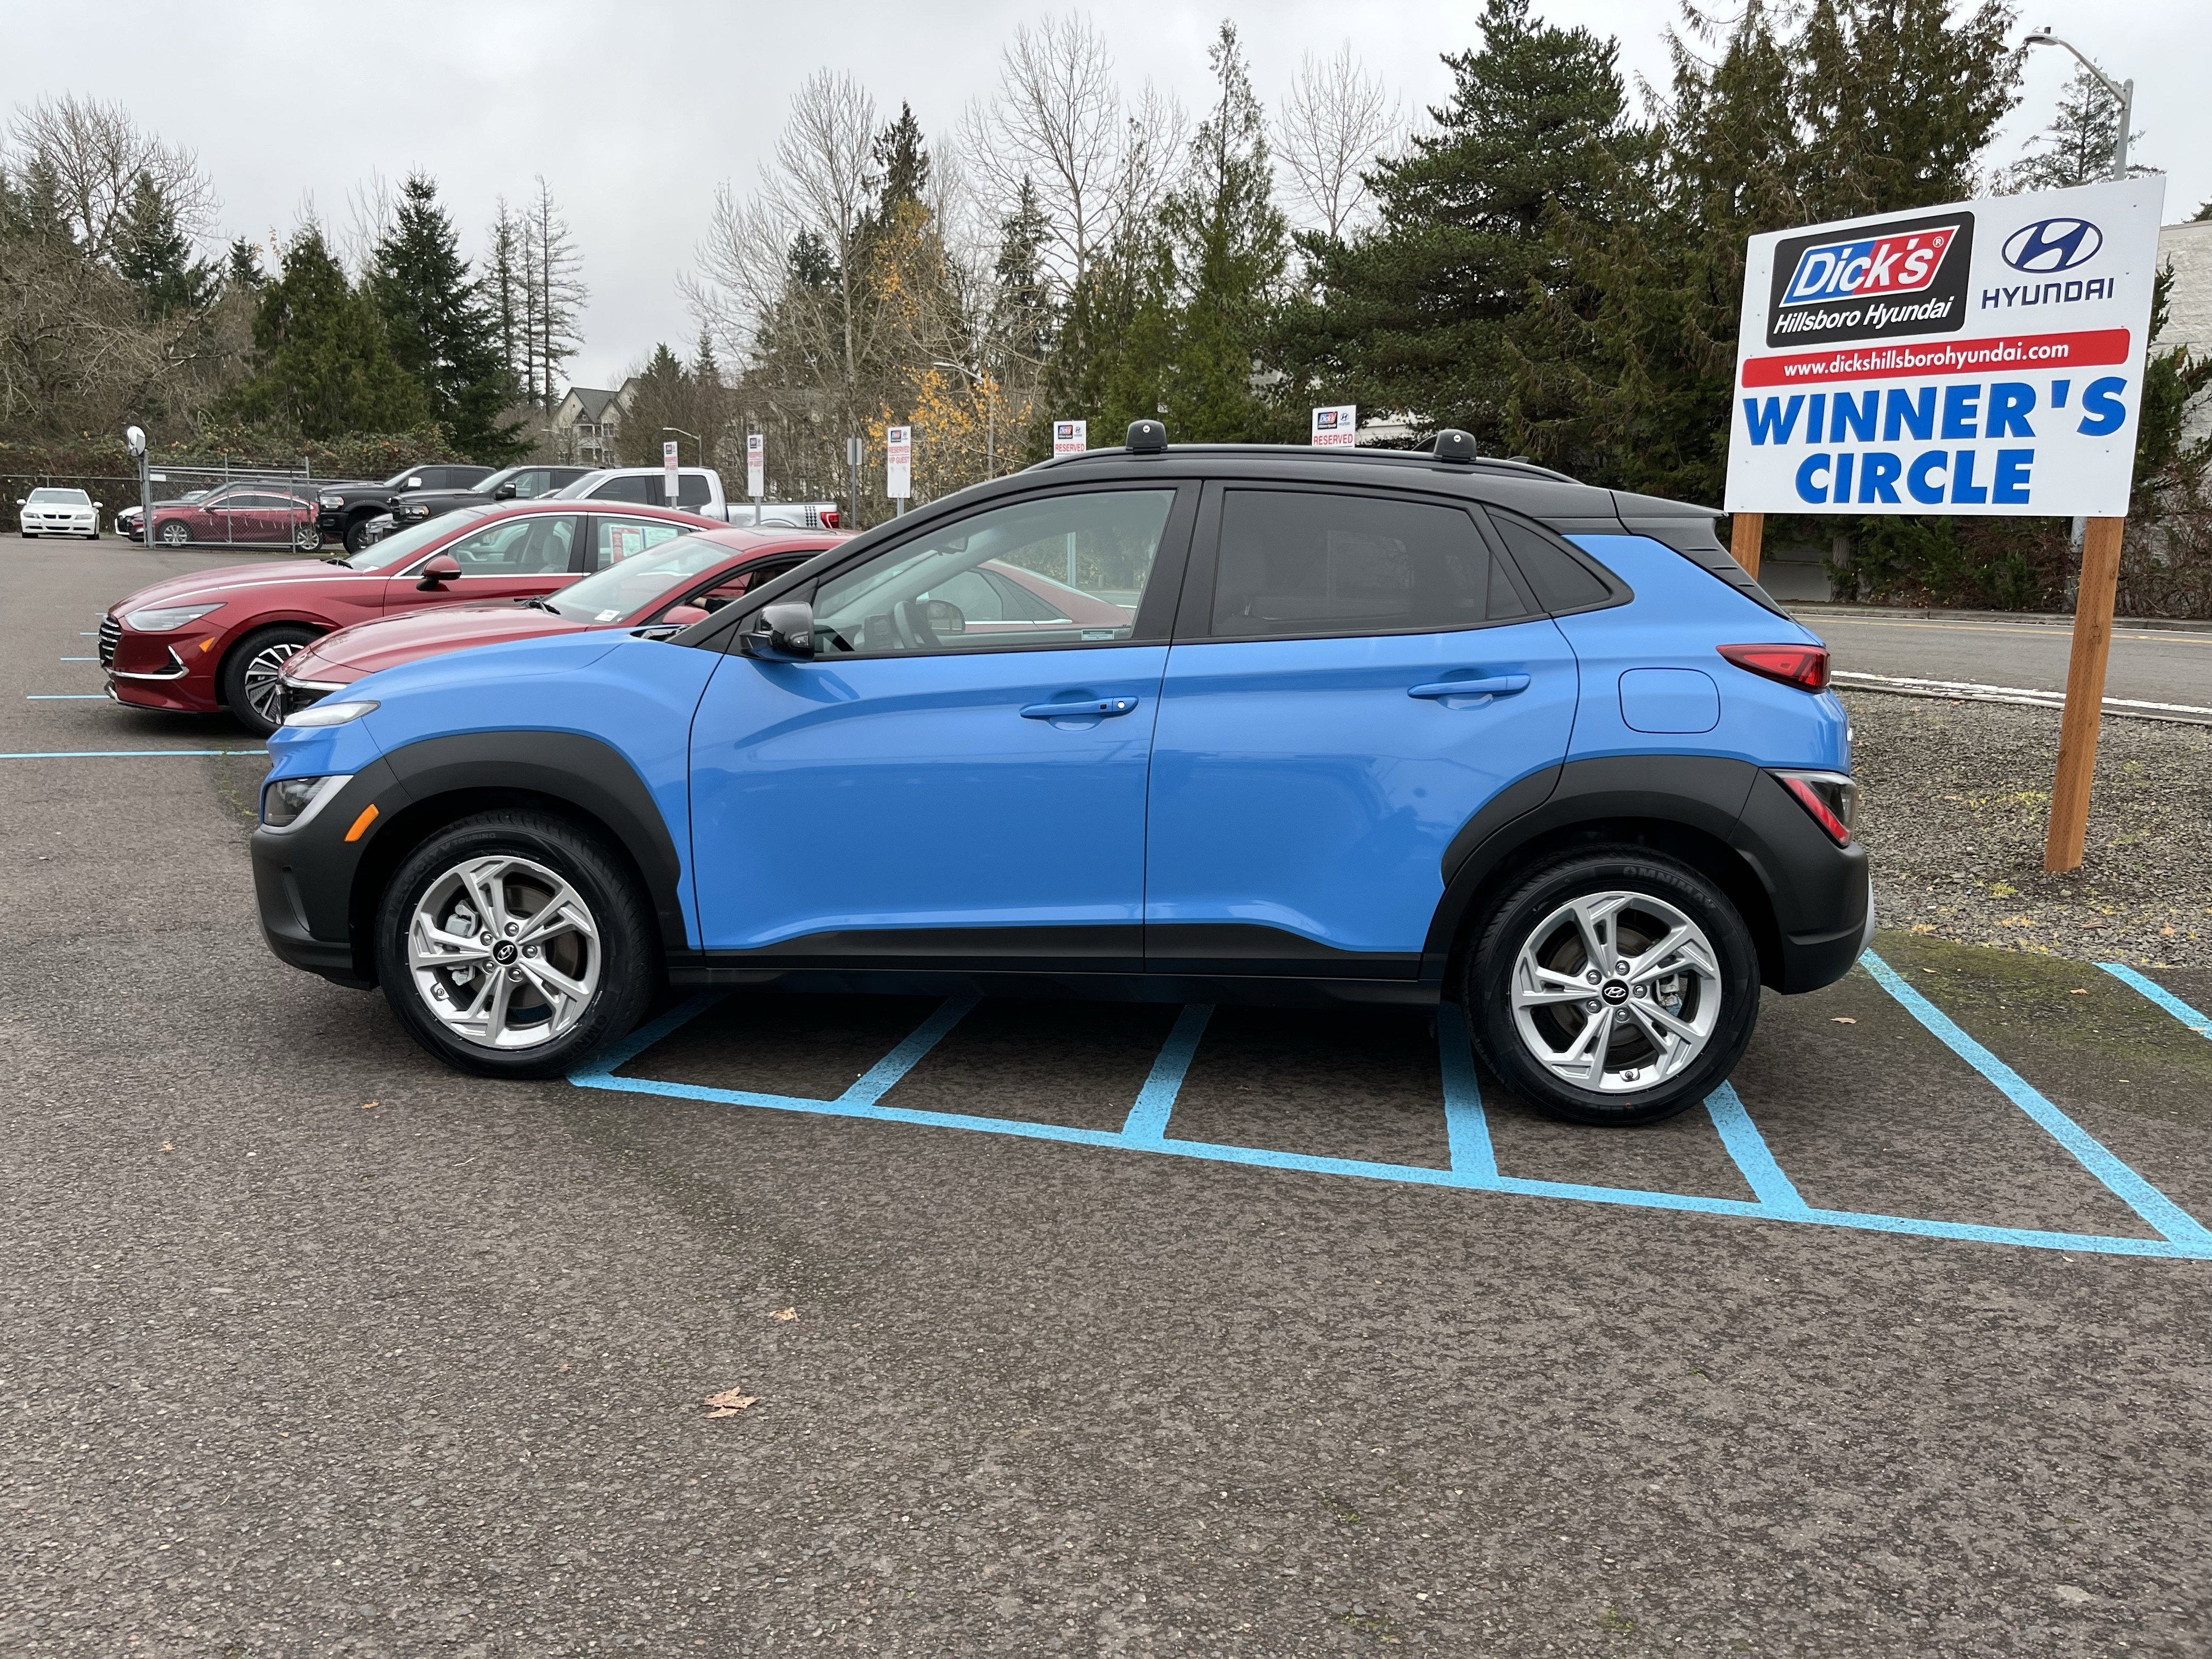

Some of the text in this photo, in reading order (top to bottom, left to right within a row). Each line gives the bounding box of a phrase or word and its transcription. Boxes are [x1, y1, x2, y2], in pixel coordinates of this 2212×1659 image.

[1982, 278, 2114, 309] HYUNDAI
[1773, 297, 1954, 335] Hillsboro Hyundai
[1784, 342, 2069, 377] www.dickshillsborohyundai.com
[1742, 376, 2128, 446] WINNER'S
[1055, 443, 1085, 452] RESERVED
[1313, 434, 1353, 445] RESERVED
[1795, 449, 2034, 505] CIRCLE
